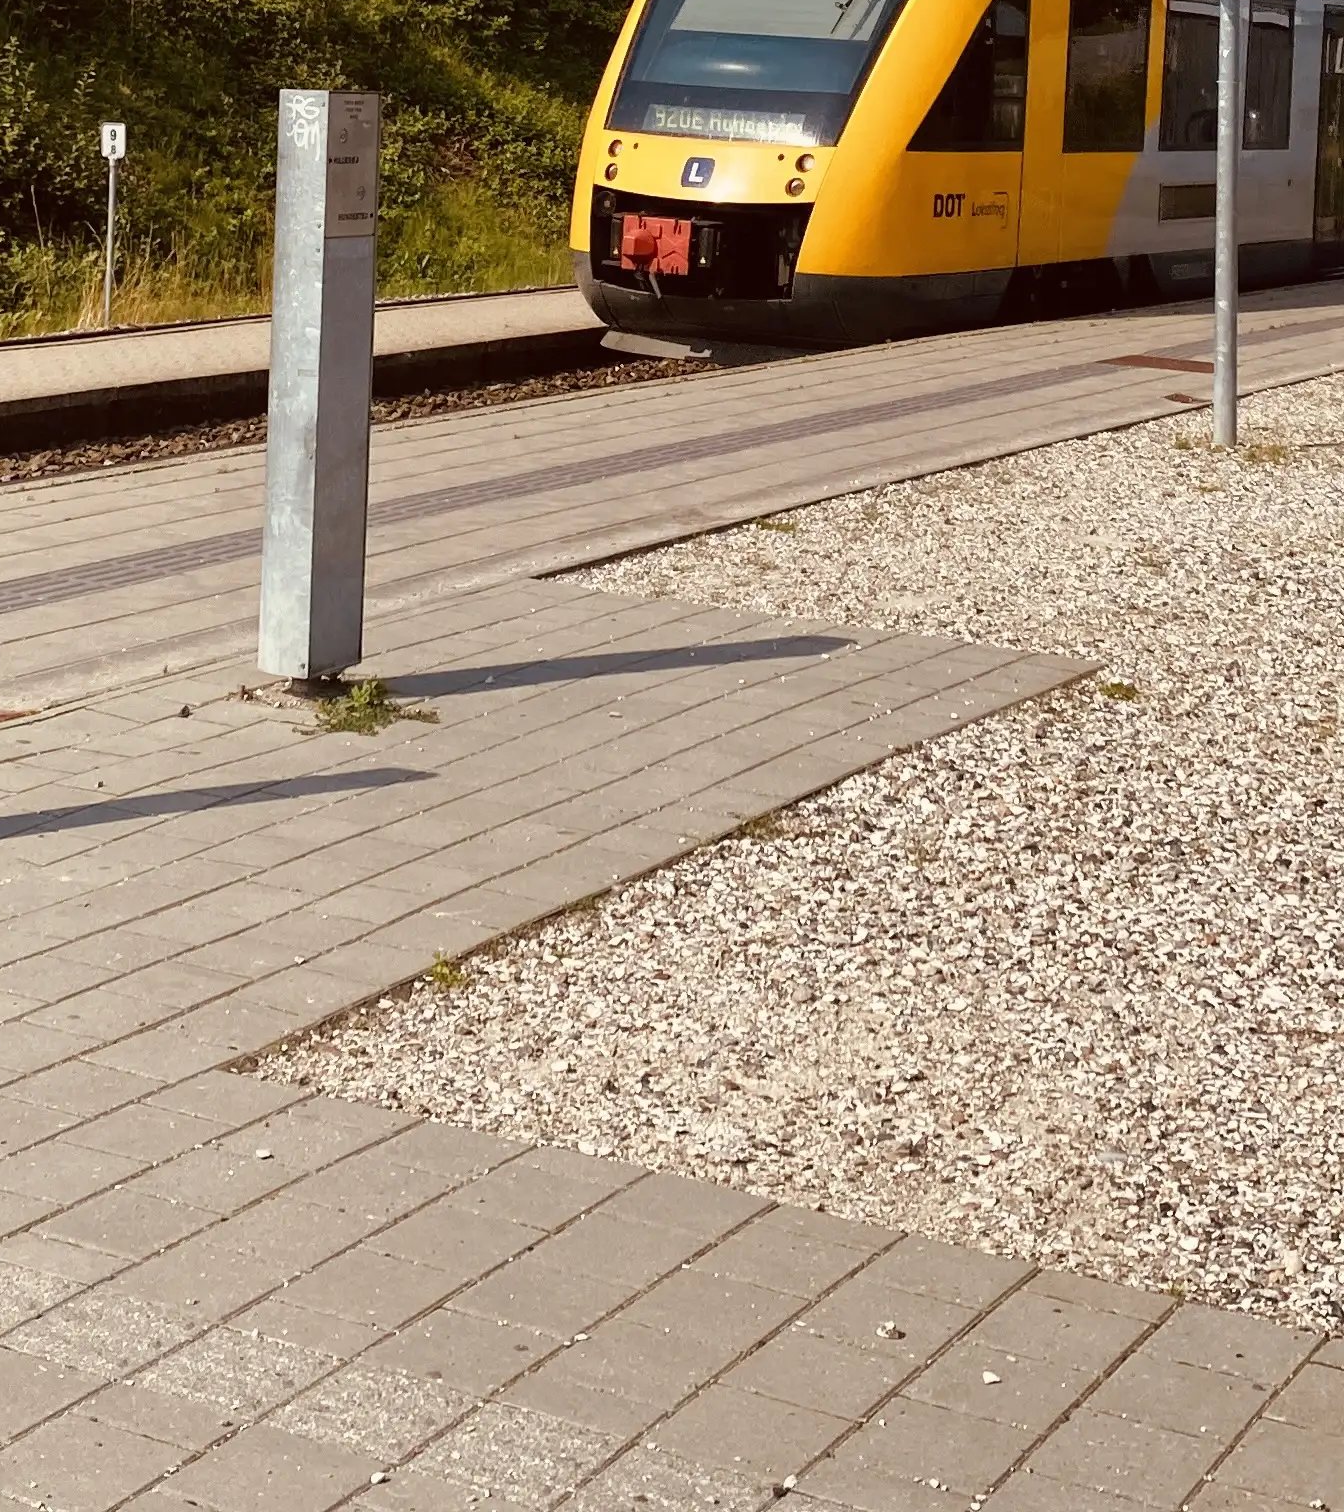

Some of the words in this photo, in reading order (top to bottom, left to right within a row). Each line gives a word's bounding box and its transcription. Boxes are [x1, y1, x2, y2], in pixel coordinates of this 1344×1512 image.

[110, 129, 117, 141] 9
[110, 144, 116, 155] 8
[933, 193, 965, 218] DOT
